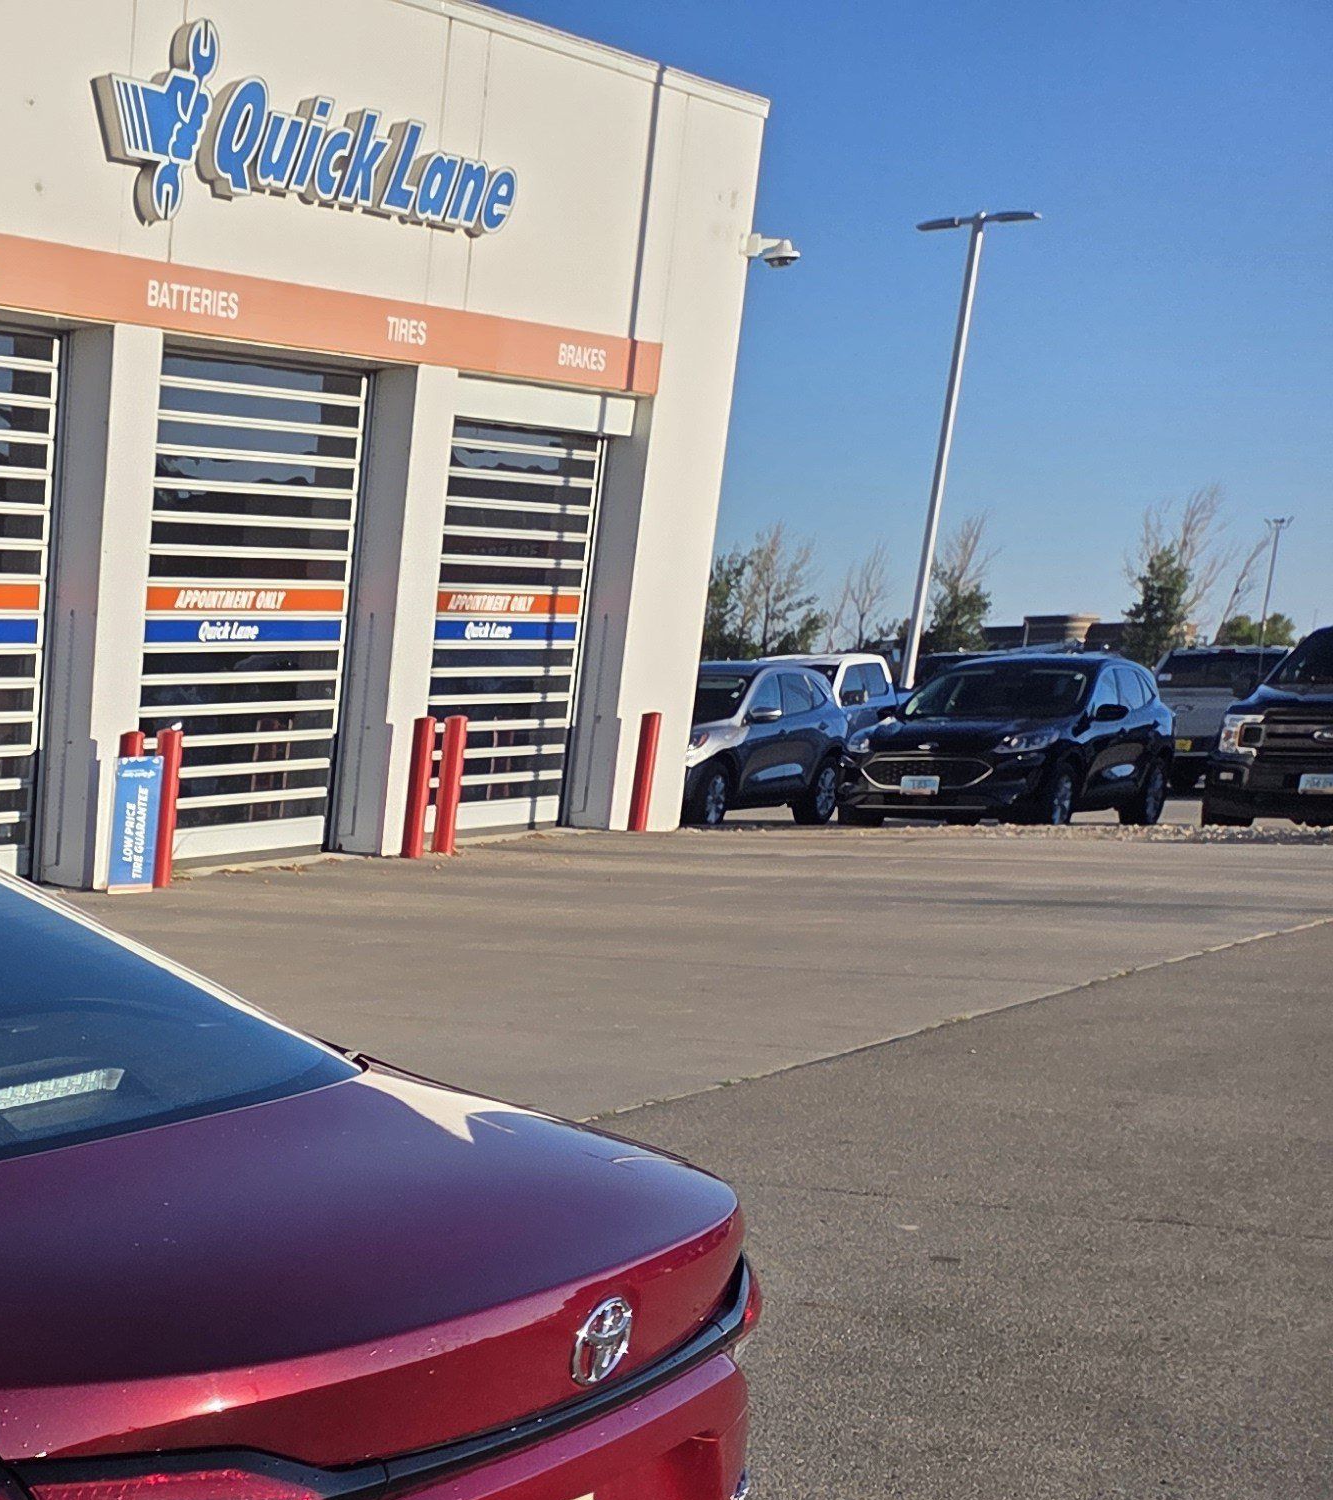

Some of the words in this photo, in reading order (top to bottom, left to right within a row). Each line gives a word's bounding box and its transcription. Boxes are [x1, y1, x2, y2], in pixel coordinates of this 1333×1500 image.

[213, 75, 392, 207] Quick
[380, 118, 518, 234] Lane
[146, 278, 239, 319] BATTERIES
[386, 315, 427, 346] TIRES
[557, 342, 607, 372] BRAKES
[174, 589, 257, 609] APPOINTMENT
[255, 590, 287, 610] ONLY
[198, 620, 231, 643] Quick
[229, 621, 260, 640] Lane
[124, 802, 137, 836] PRICE
[122, 835, 135, 863] LOW
[131, 855, 144, 879] TIRE
